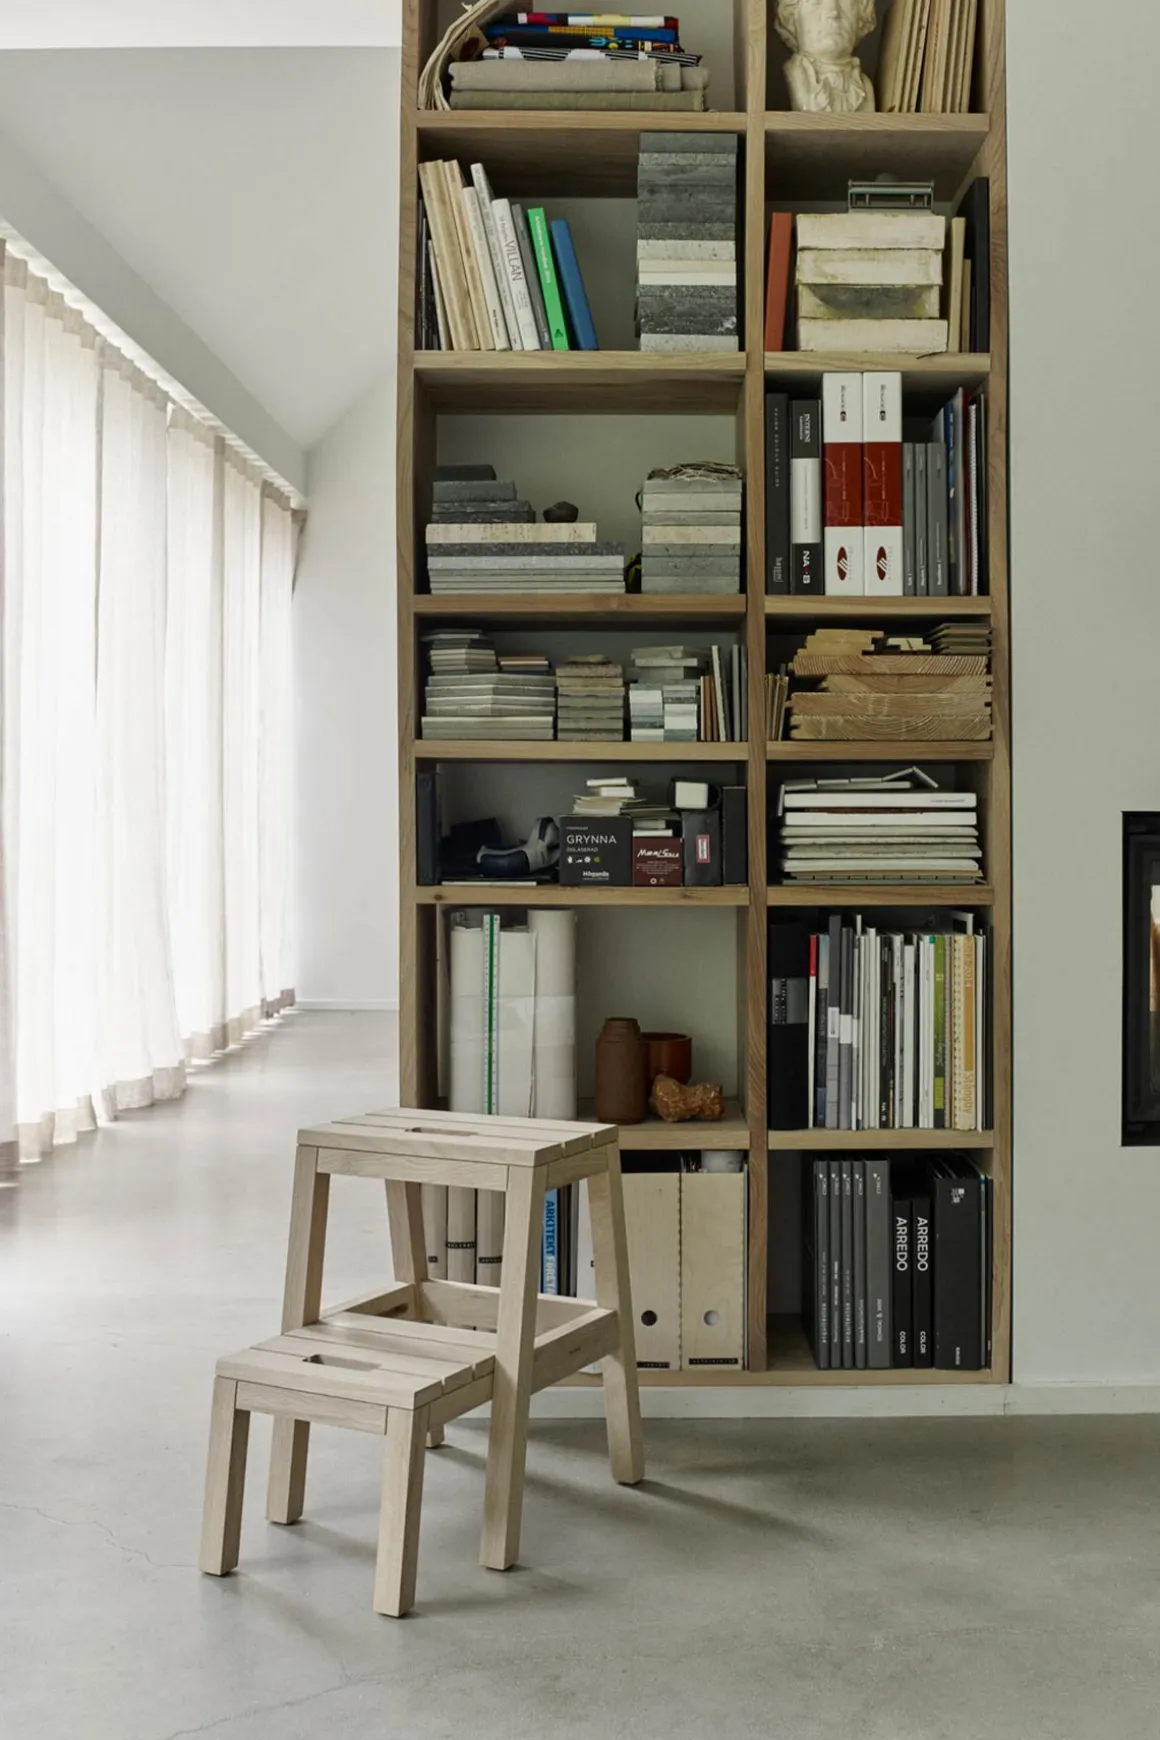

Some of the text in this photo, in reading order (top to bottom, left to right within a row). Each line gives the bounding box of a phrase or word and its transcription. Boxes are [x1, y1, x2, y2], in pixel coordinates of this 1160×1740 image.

[504, 239, 522, 282] VILLAN
[566, 834, 617, 845] GRYNNA
[896, 1216, 908, 1271] ARREDO
[917, 1216, 929, 1271] ARREDO
